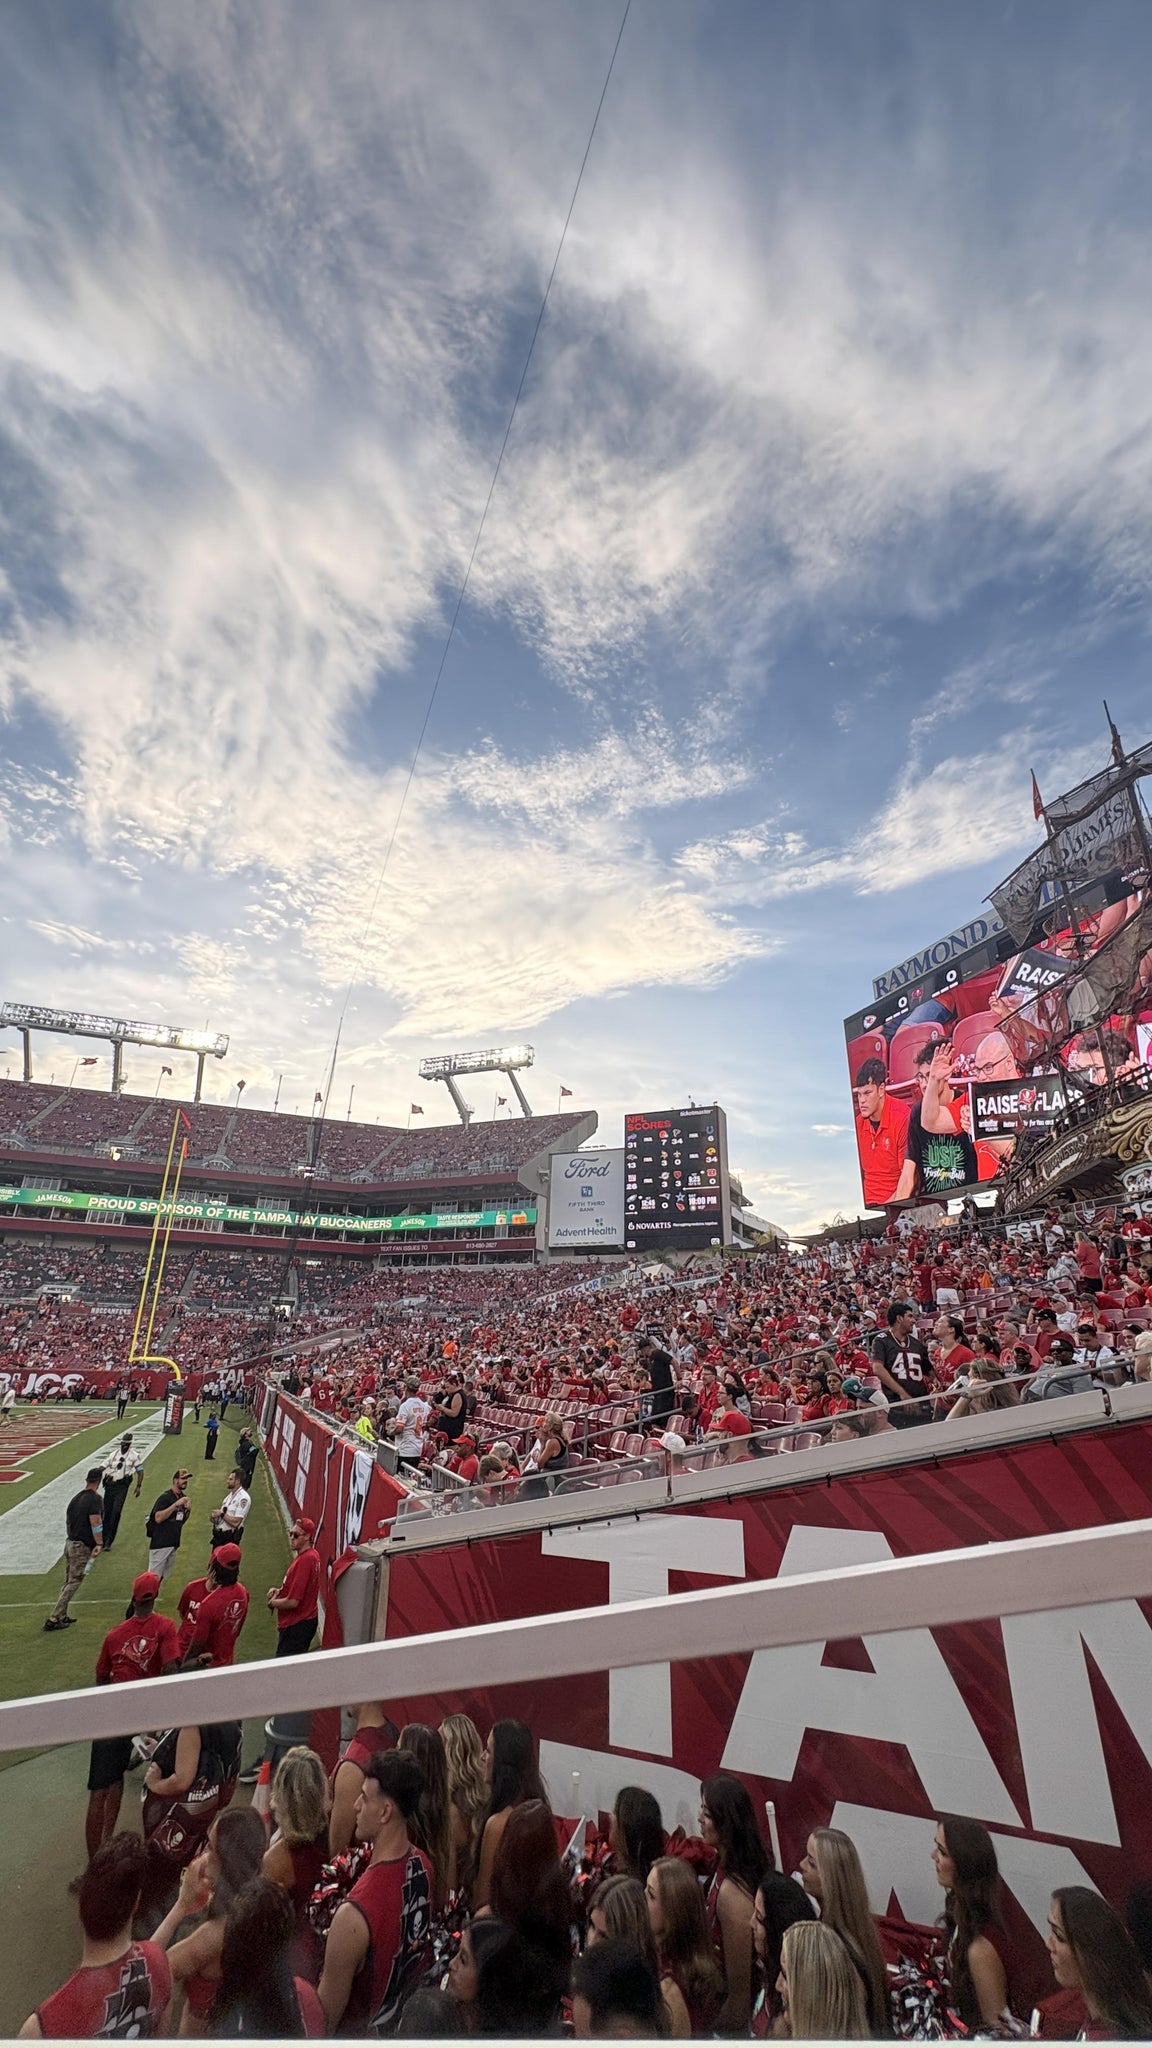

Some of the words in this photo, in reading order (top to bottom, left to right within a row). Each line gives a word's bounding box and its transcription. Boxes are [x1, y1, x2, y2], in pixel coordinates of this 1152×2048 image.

[1073, 801, 1125, 854] JAMES
[874, 919, 988, 999] RAYMOND
[946, 969, 957, 983] 0
[1016, 963, 1066, 986] RAIS
[898, 996, 908, 1009] 0
[977, 1095, 1019, 1116] RAISE
[627, 1115, 646, 1124] NFL
[627, 1120, 671, 1131] SCORES
[928, 1144, 961, 1168] USF
[564, 1157, 611, 1179] Ford
[35, 1193, 74, 1204] JAMESON
[707, 1195, 717, 1204] PM
[88, 1197, 136, 1210] PROUD
[138, 1201, 203, 1216] SPONSOR
[206, 1207, 224, 1217] OF
[227, 1209, 251, 1220] THE
[253, 1211, 292, 1224] TAMPA
[320, 1216, 392, 1229] BUCCANEERS
[400, 1217, 426, 1227] JAMESON
[636, 1222, 672, 1230] NOVARTIS
[556, 1226, 617, 1237] AdventHealth
[891, 1352, 923, 1381] 45
[318, 1389, 326, 1400] 6
